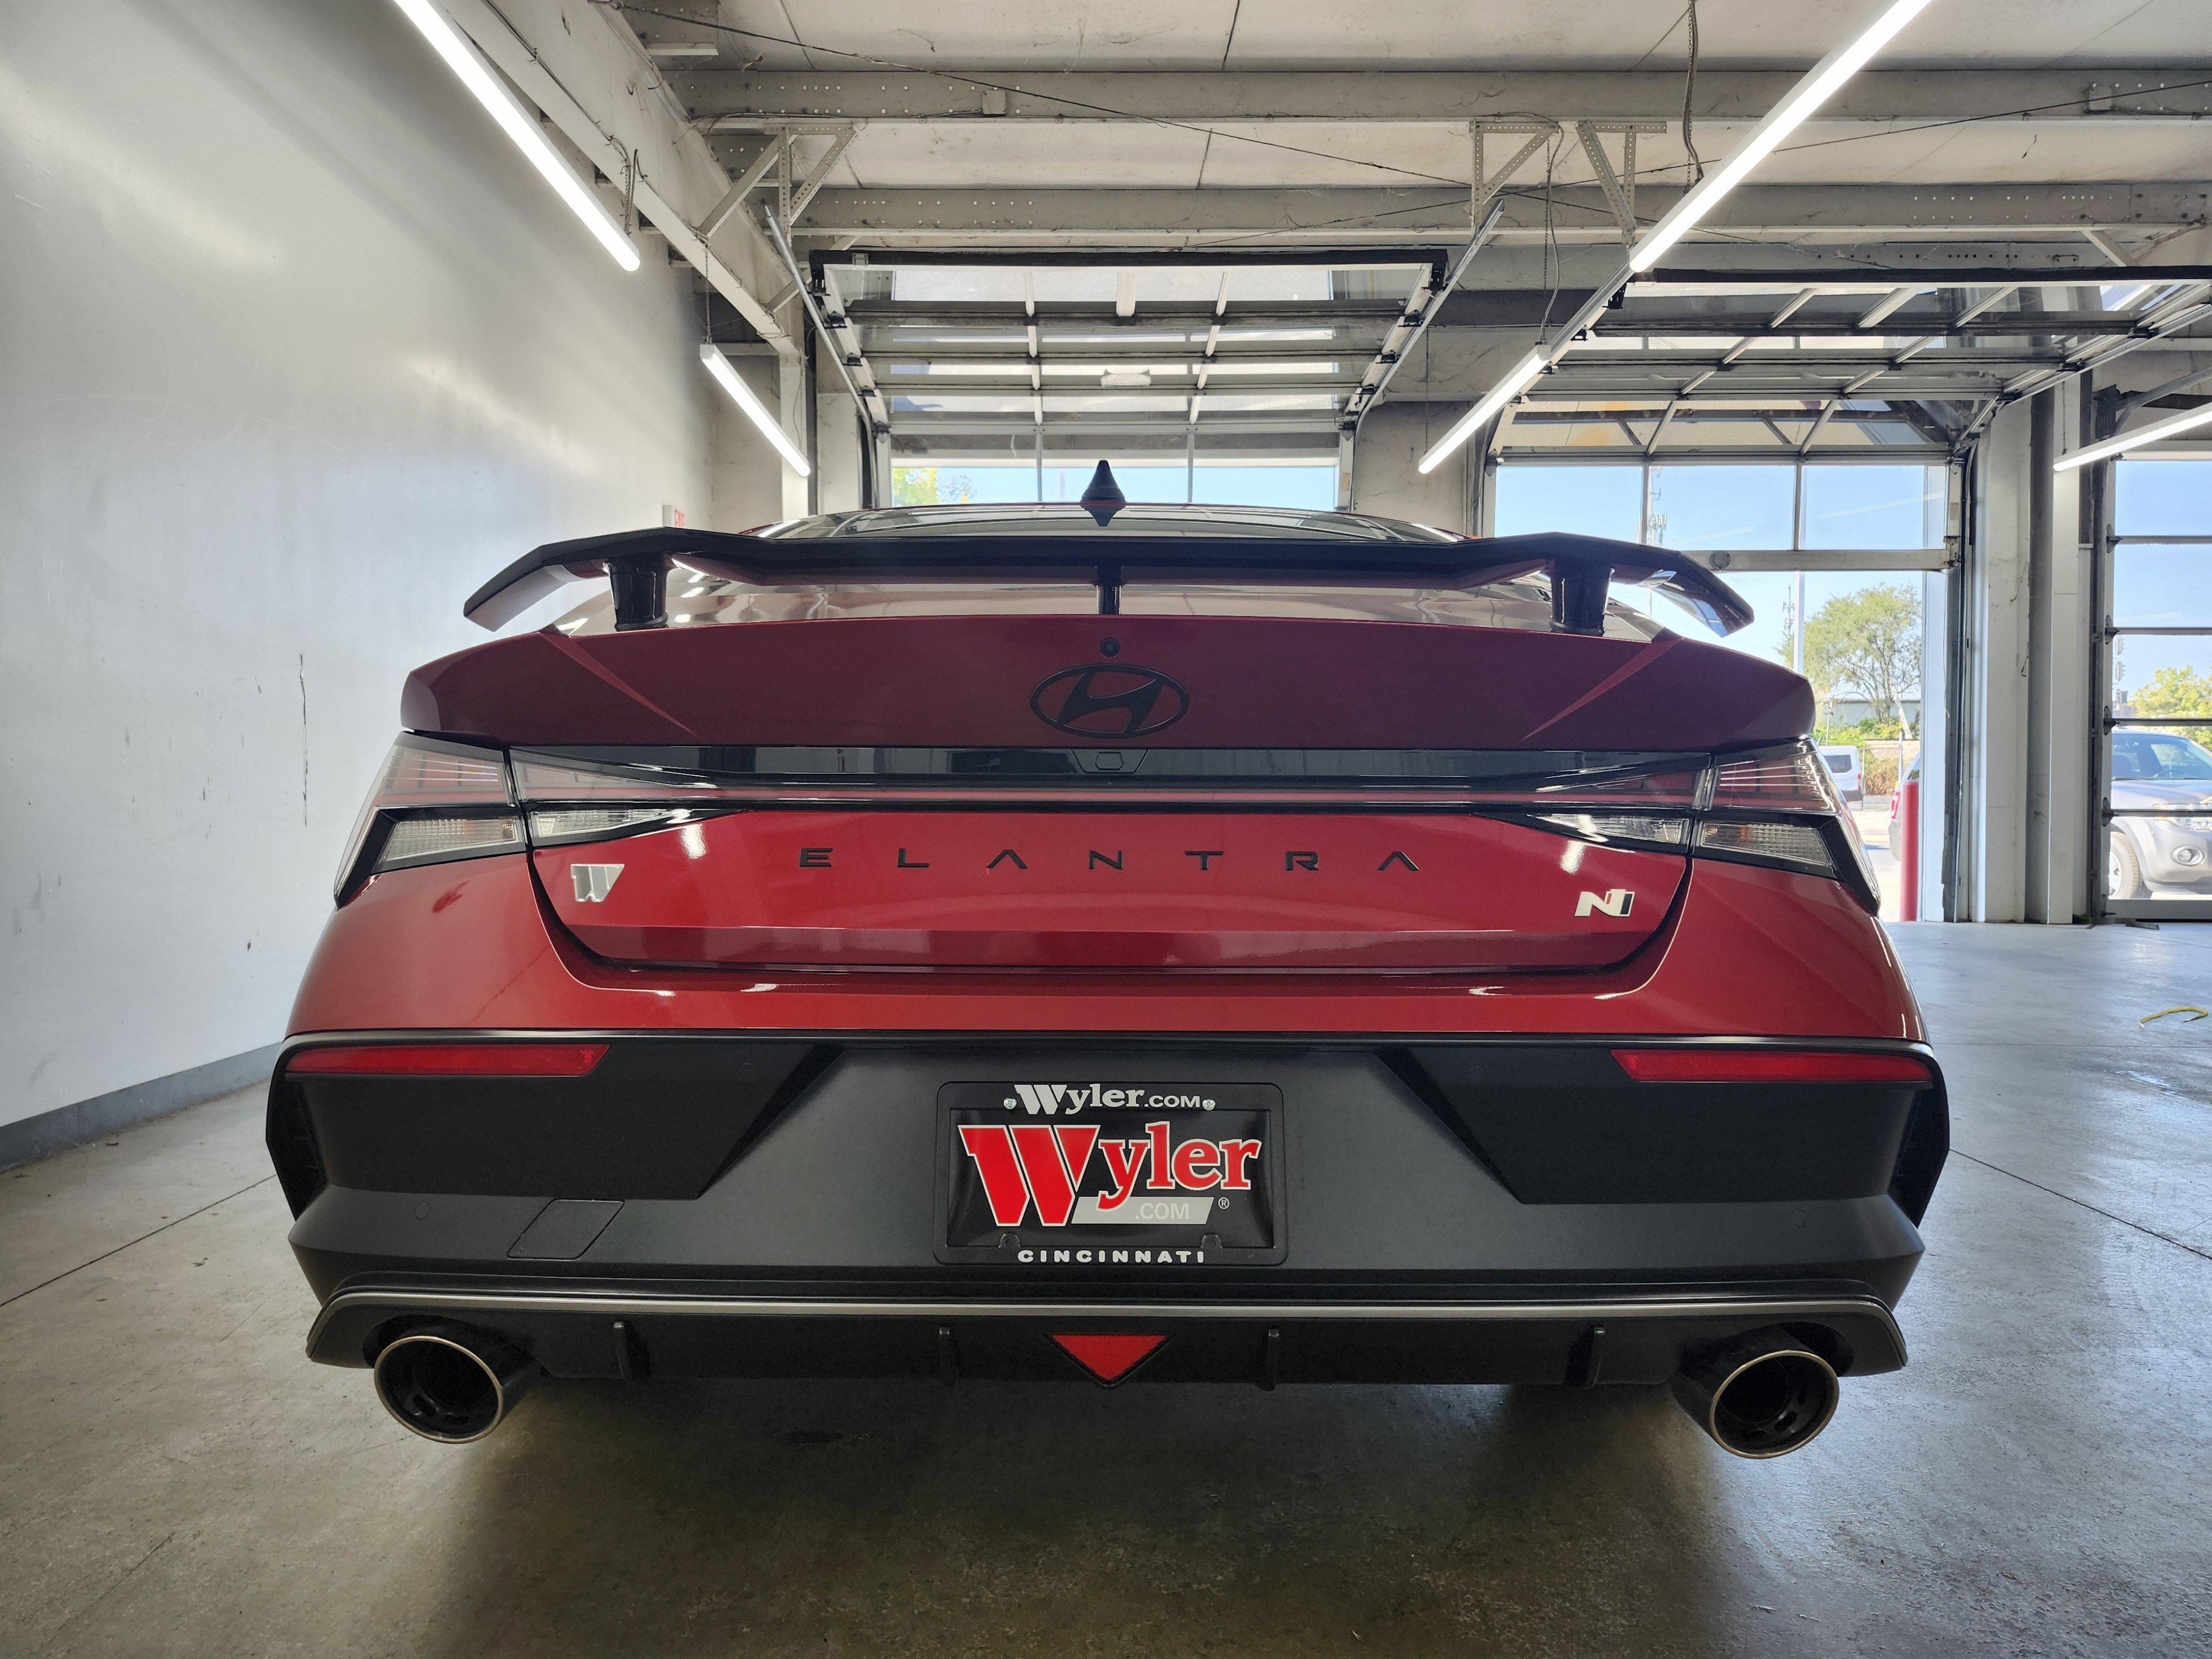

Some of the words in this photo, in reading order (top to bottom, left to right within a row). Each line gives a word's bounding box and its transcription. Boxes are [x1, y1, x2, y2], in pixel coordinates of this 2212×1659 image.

[798, 847, 1420, 871] ELANTRA
[957, 1120, 1263, 1227] Wyler
[1134, 1202, 1190, 1220] .COM
[1017, 1250, 1204, 1264] CINCINNATI
